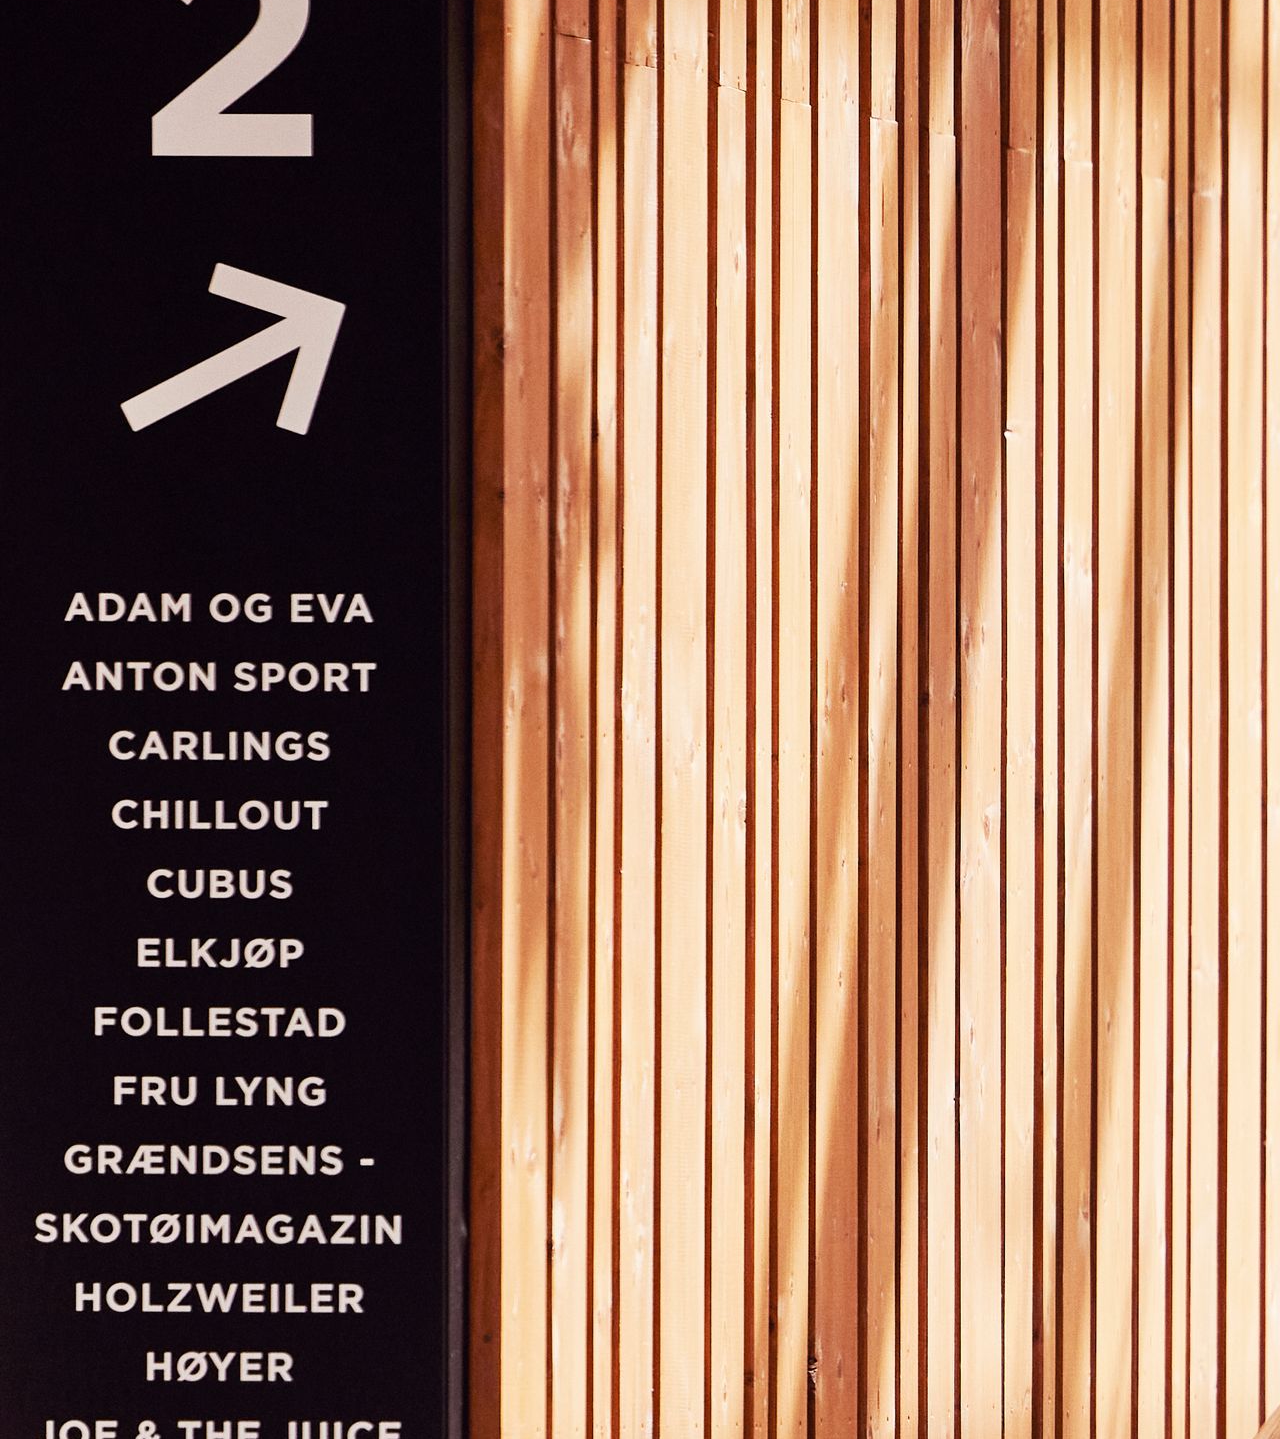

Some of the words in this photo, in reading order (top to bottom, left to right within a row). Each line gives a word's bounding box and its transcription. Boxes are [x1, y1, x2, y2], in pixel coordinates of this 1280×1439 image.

[64, 592, 191, 623] ADAM
[209, 592, 272, 623] OG
[290, 593, 374, 623] EVA
[61, 661, 216, 692] ANTON
[233, 661, 377, 693] SPORT
[108, 730, 330, 762] CARLINGS
[111, 799, 329, 831] CHILLOUT
[146, 868, 293, 900] CUBUS
[137, 937, 304, 969] ELKJØP
[94, 1006, 346, 1038] FOLLESTAD
[113, 1075, 197, 1106] FRU
[215, 1076, 326, 1107] LYNG
[63, 1144, 344, 1176] GRÆNDSENS
[359, 1158, 375, 1166] -
[34, 1212, 402, 1245] SKOTØIMAGAZIN
[75, 1282, 364, 1314] HOLZWEILER
[146, 1351, 293, 1382] HØYER
